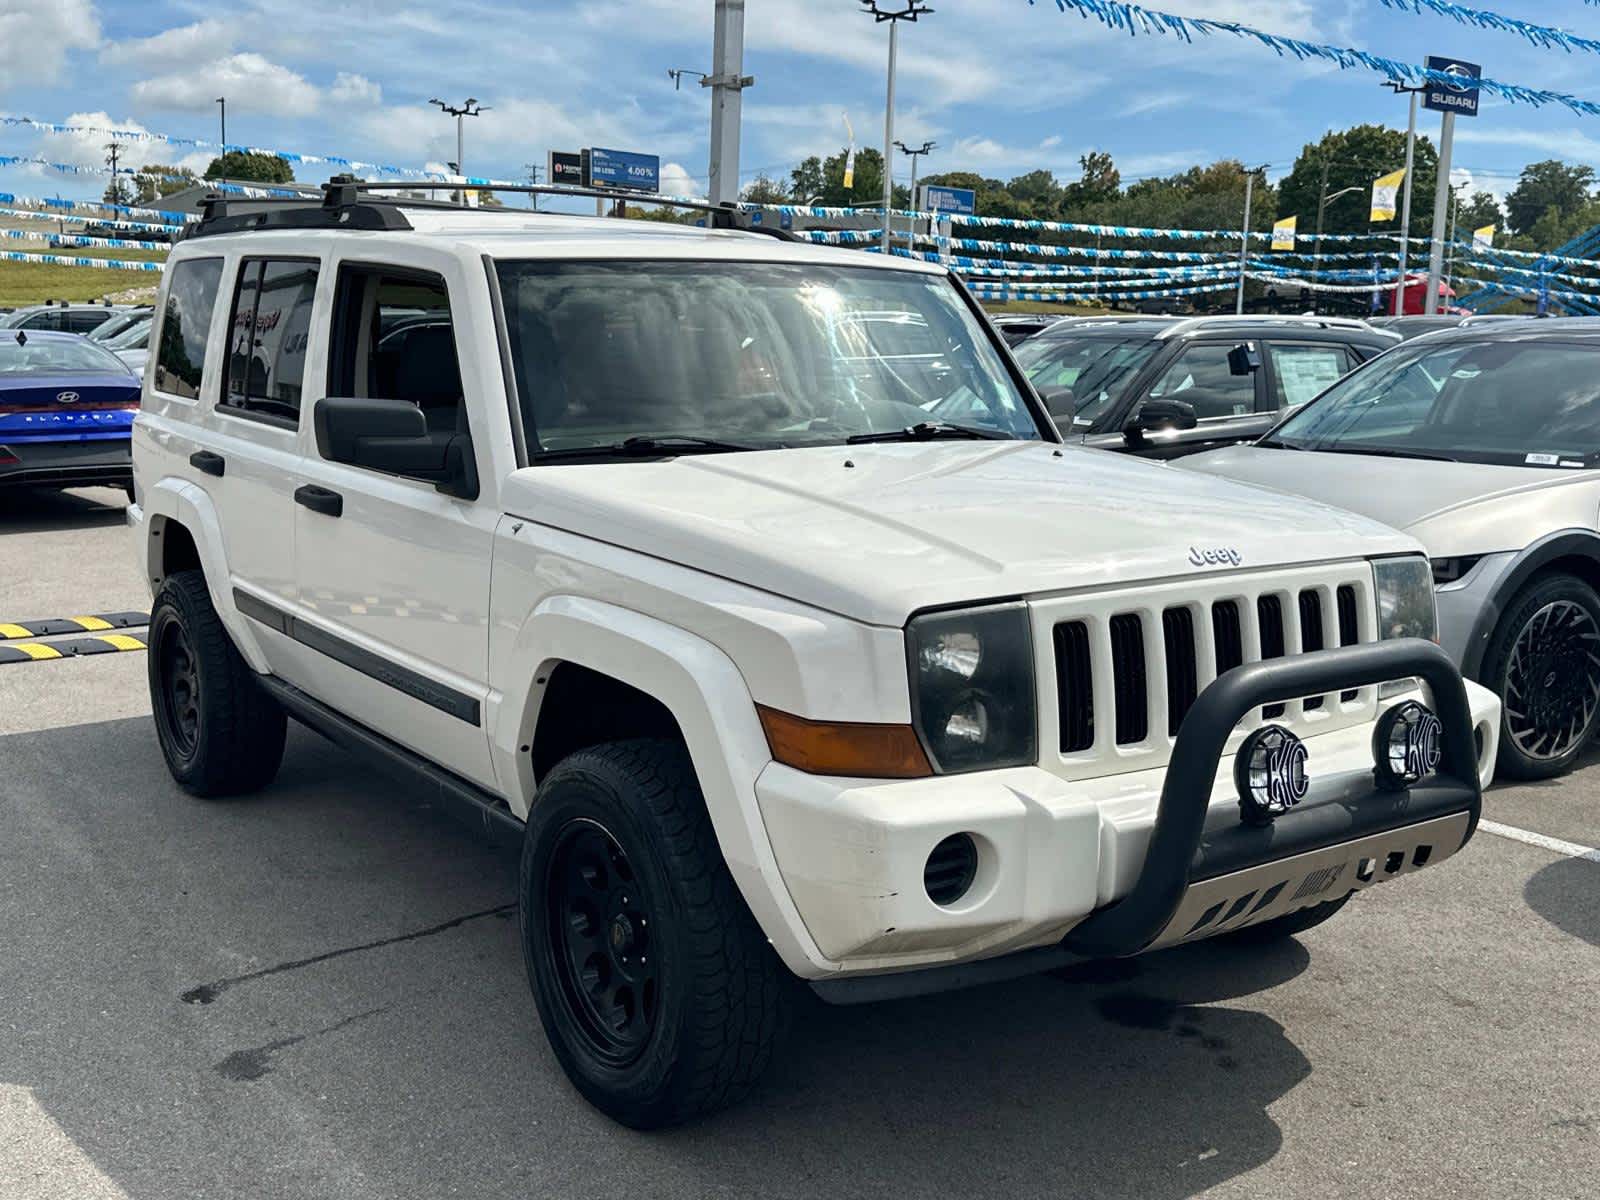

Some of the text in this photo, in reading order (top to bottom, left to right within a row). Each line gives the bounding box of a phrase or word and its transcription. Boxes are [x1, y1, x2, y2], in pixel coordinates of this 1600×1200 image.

[1432, 92, 1476, 109] SUBARU
[628, 166, 653, 177] 4.00%
[25, 413, 113, 422] ELANTRA
[1189, 546, 1242, 567] Jeep
[1408, 713, 1443, 777] KC
[1270, 738, 1309, 808] KC
